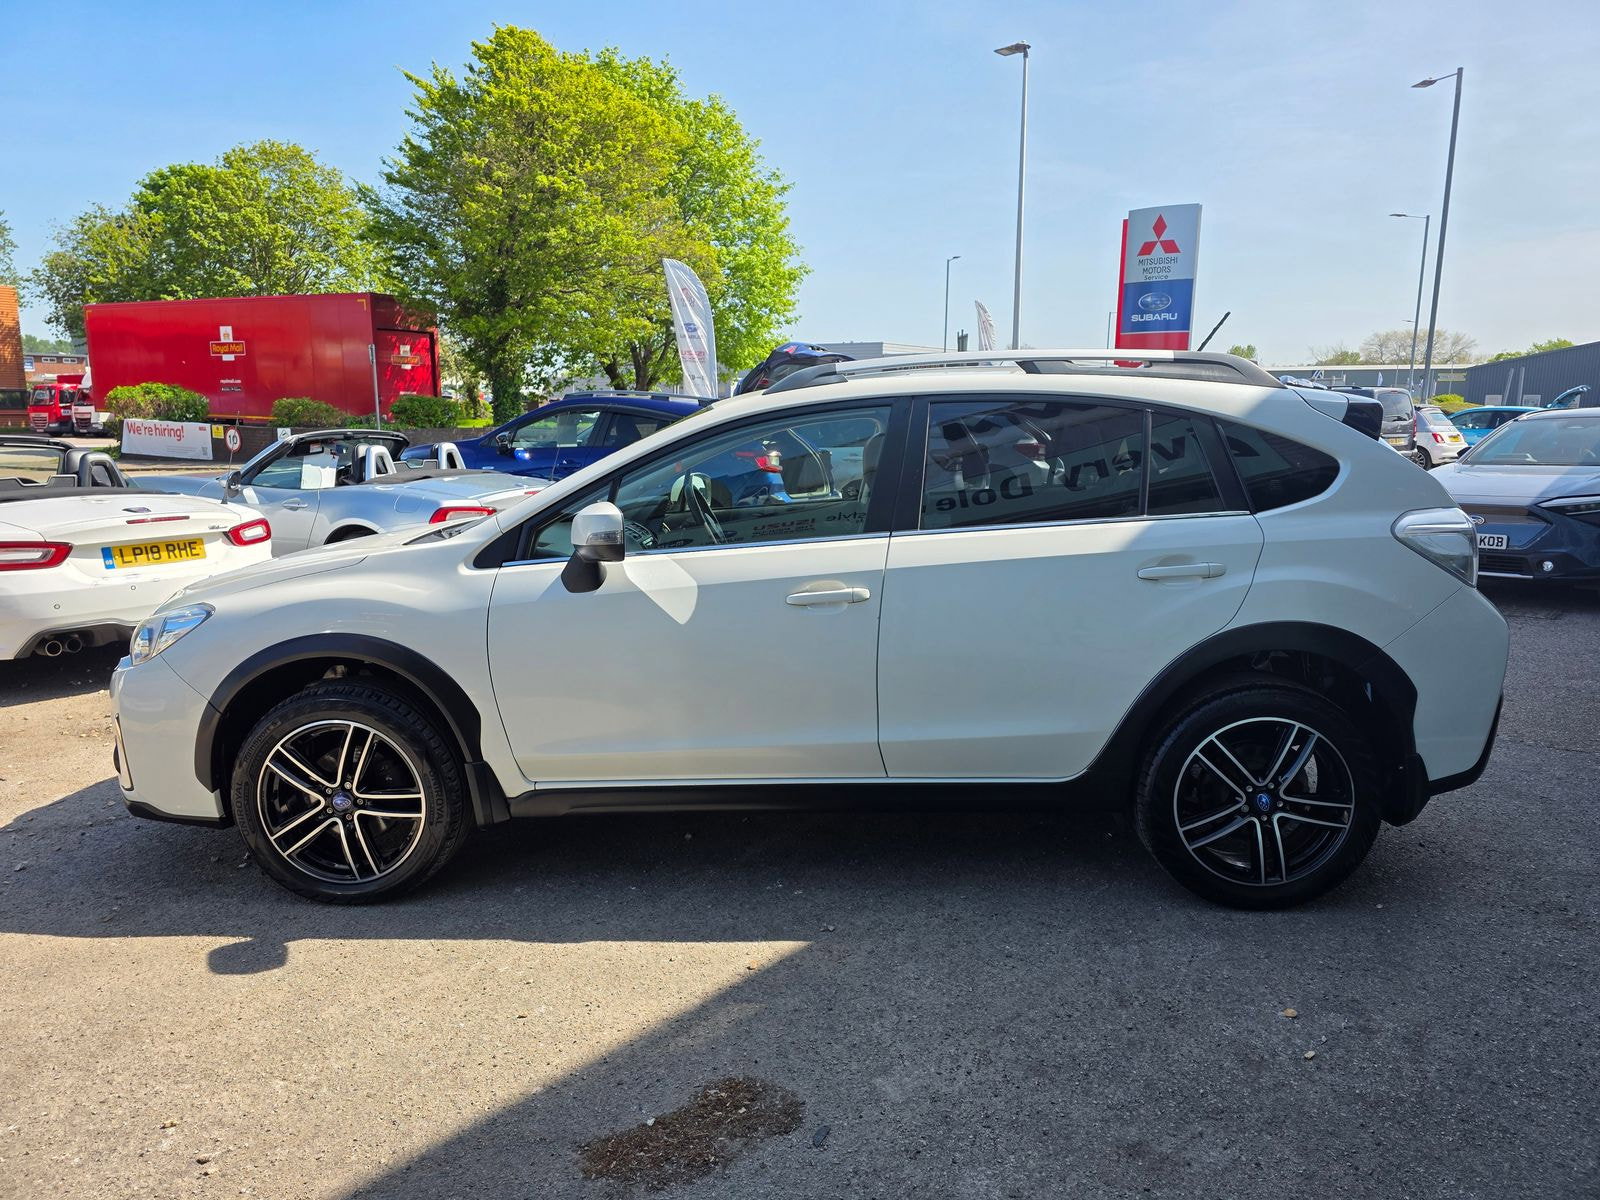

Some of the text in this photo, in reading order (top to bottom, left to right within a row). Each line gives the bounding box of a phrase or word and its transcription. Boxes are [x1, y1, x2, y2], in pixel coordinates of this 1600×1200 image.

[1137, 256, 1178, 266] MITSUBISHI
[1142, 265, 1171, 275] MOTORS
[1131, 313, 1178, 322] SUBARU
[212, 343, 243, 354] Royal Mail
[126, 422, 185, 442] We're hiring!
[229, 434, 238, 445] 10
[1479, 535, 1504, 547] KOB
[165, 541, 200, 559] RHE
[429, 769, 444, 827] UNIROYAL
[235, 781, 249, 837] UNIROYAL
